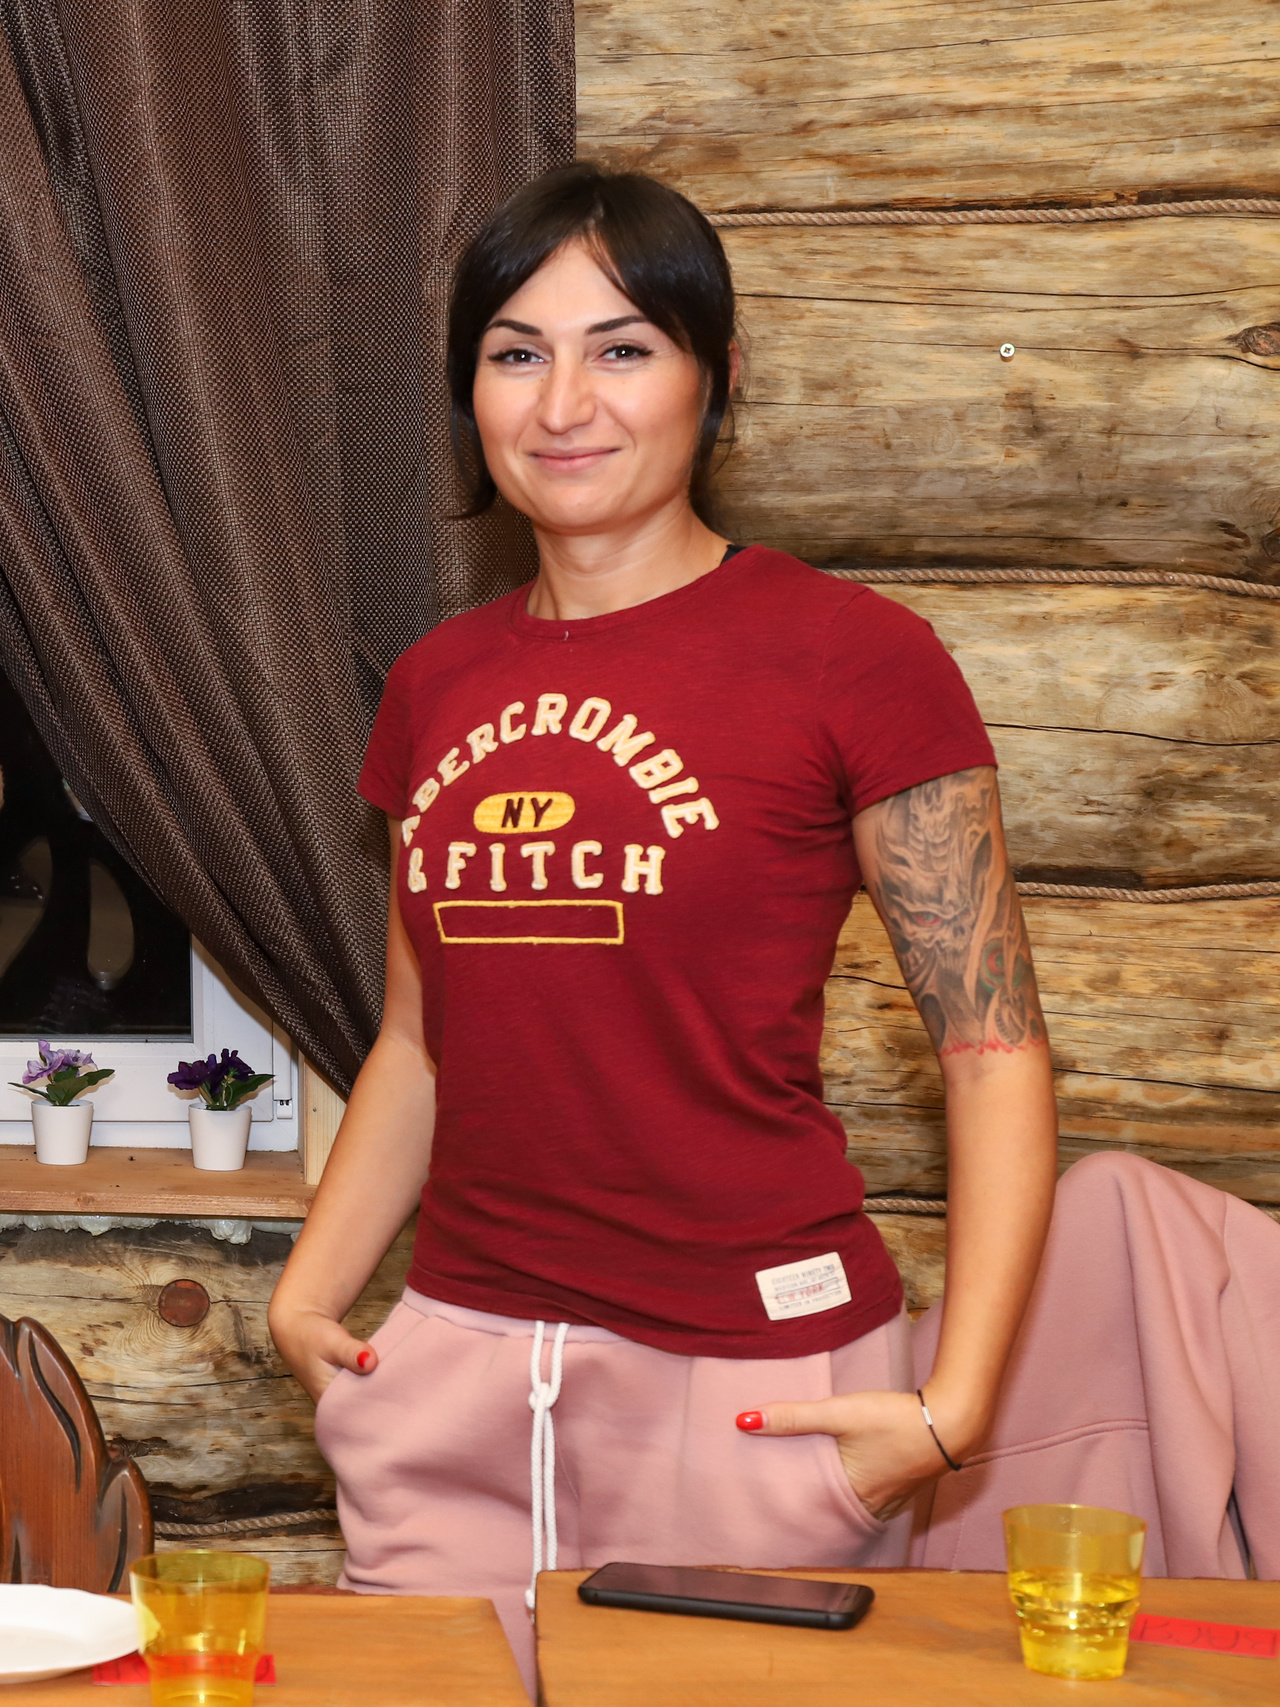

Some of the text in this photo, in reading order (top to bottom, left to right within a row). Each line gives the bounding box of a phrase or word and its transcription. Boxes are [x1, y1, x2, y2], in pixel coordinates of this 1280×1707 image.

[401, 692, 720, 848] ABERCROMBIE
[501, 797, 553, 828] NY
[445, 840, 666, 895] FITCH
